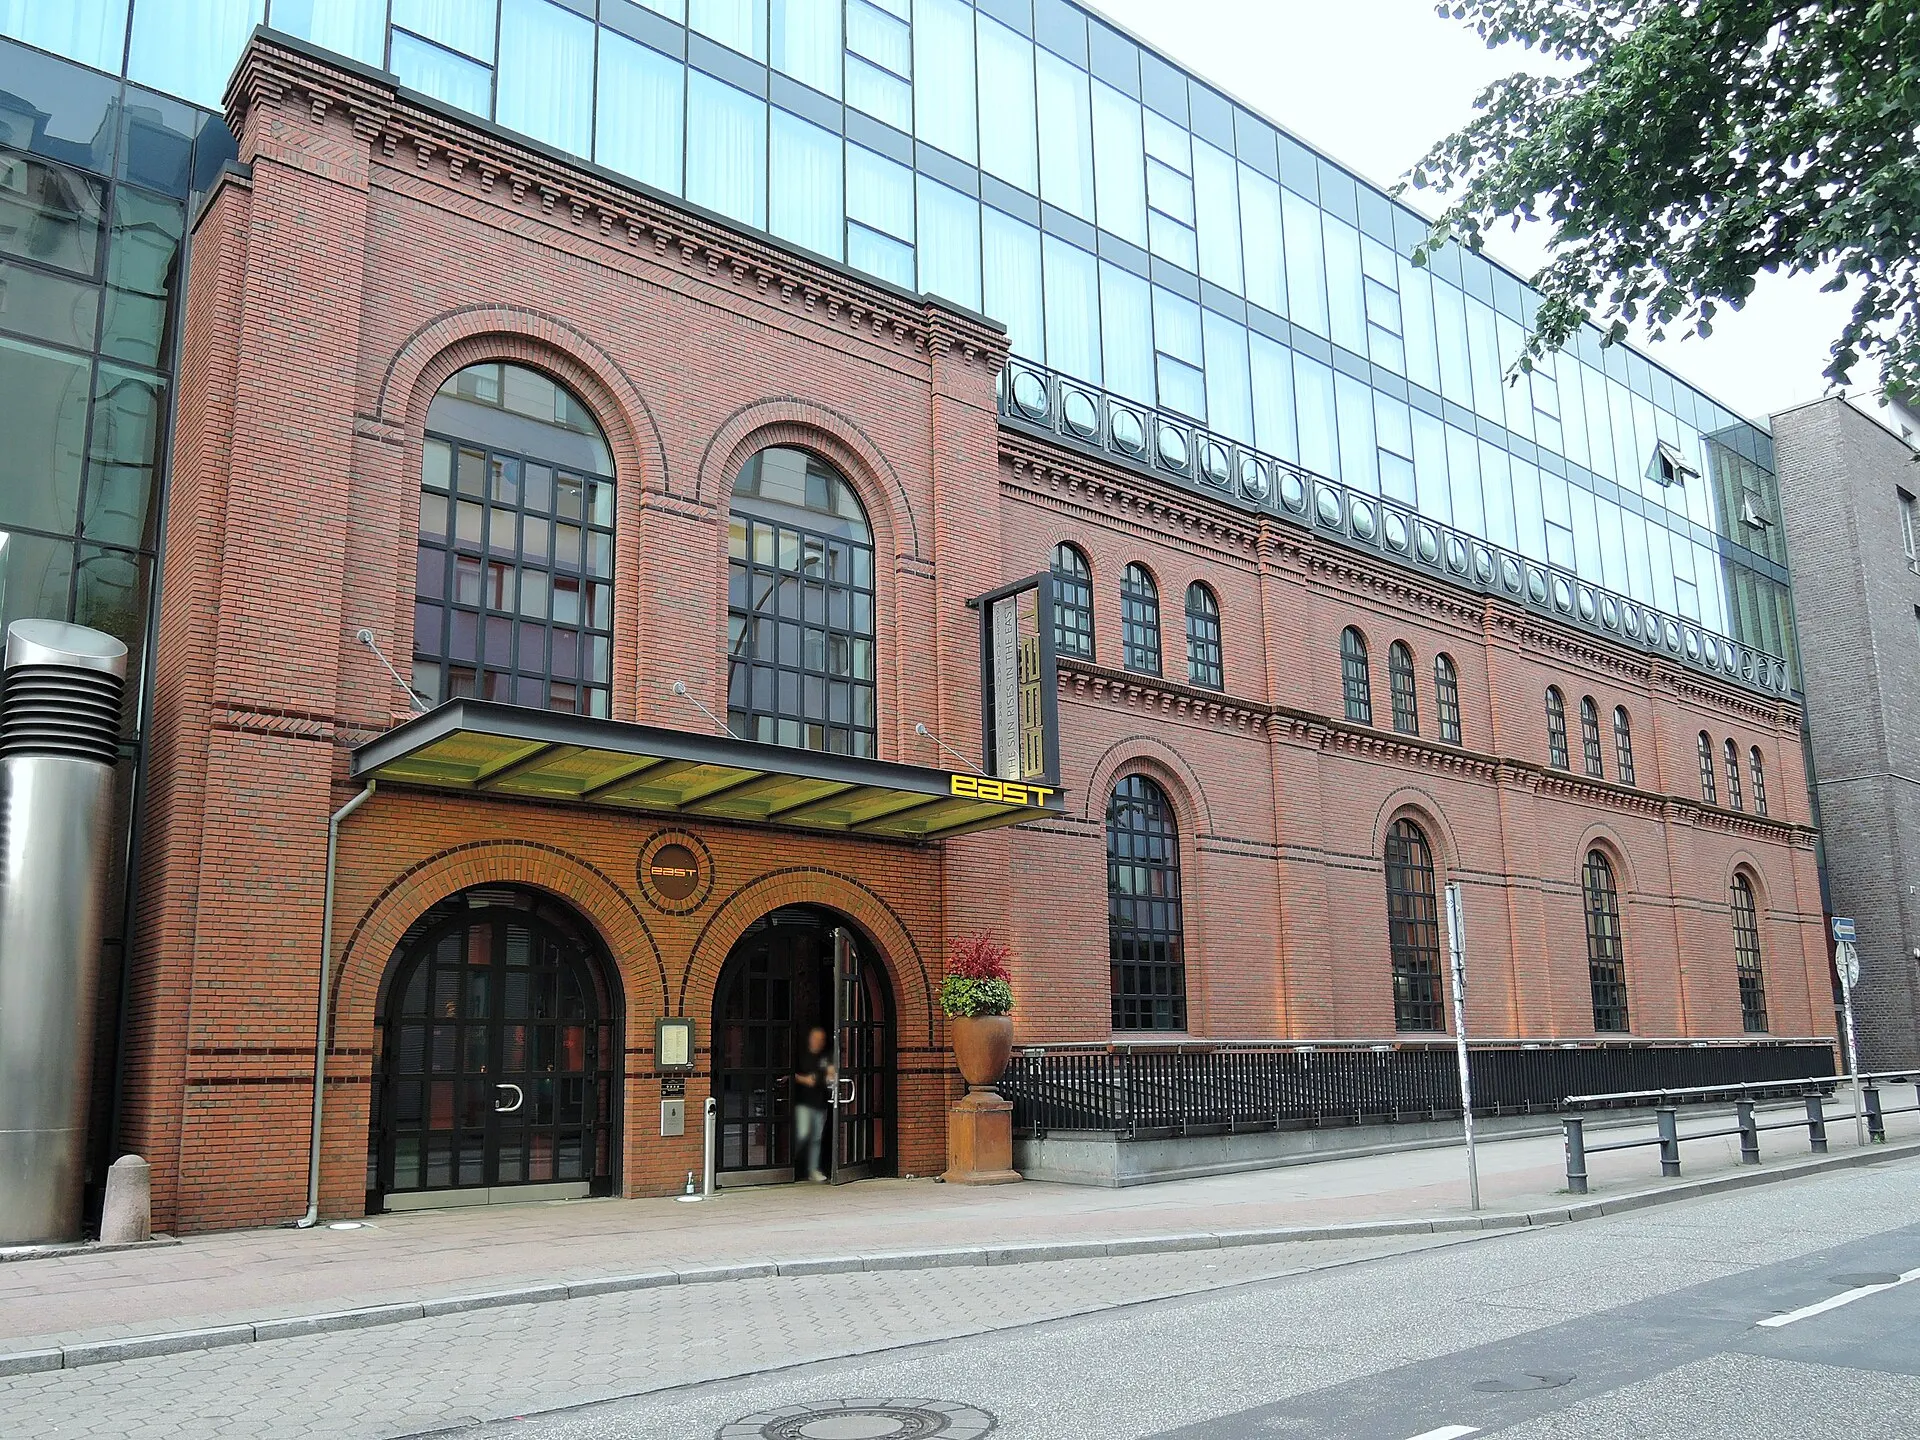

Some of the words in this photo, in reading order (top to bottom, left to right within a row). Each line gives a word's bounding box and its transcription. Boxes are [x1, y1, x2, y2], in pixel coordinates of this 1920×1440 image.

[1004, 605, 1013, 634] EAST
[1005, 637, 1013, 664] THE
[1006, 666, 1014, 680] IN
[1006, 683, 1015, 717] RISES
[1007, 721, 1016, 748] SUN
[1008, 751, 1016, 777] THE
